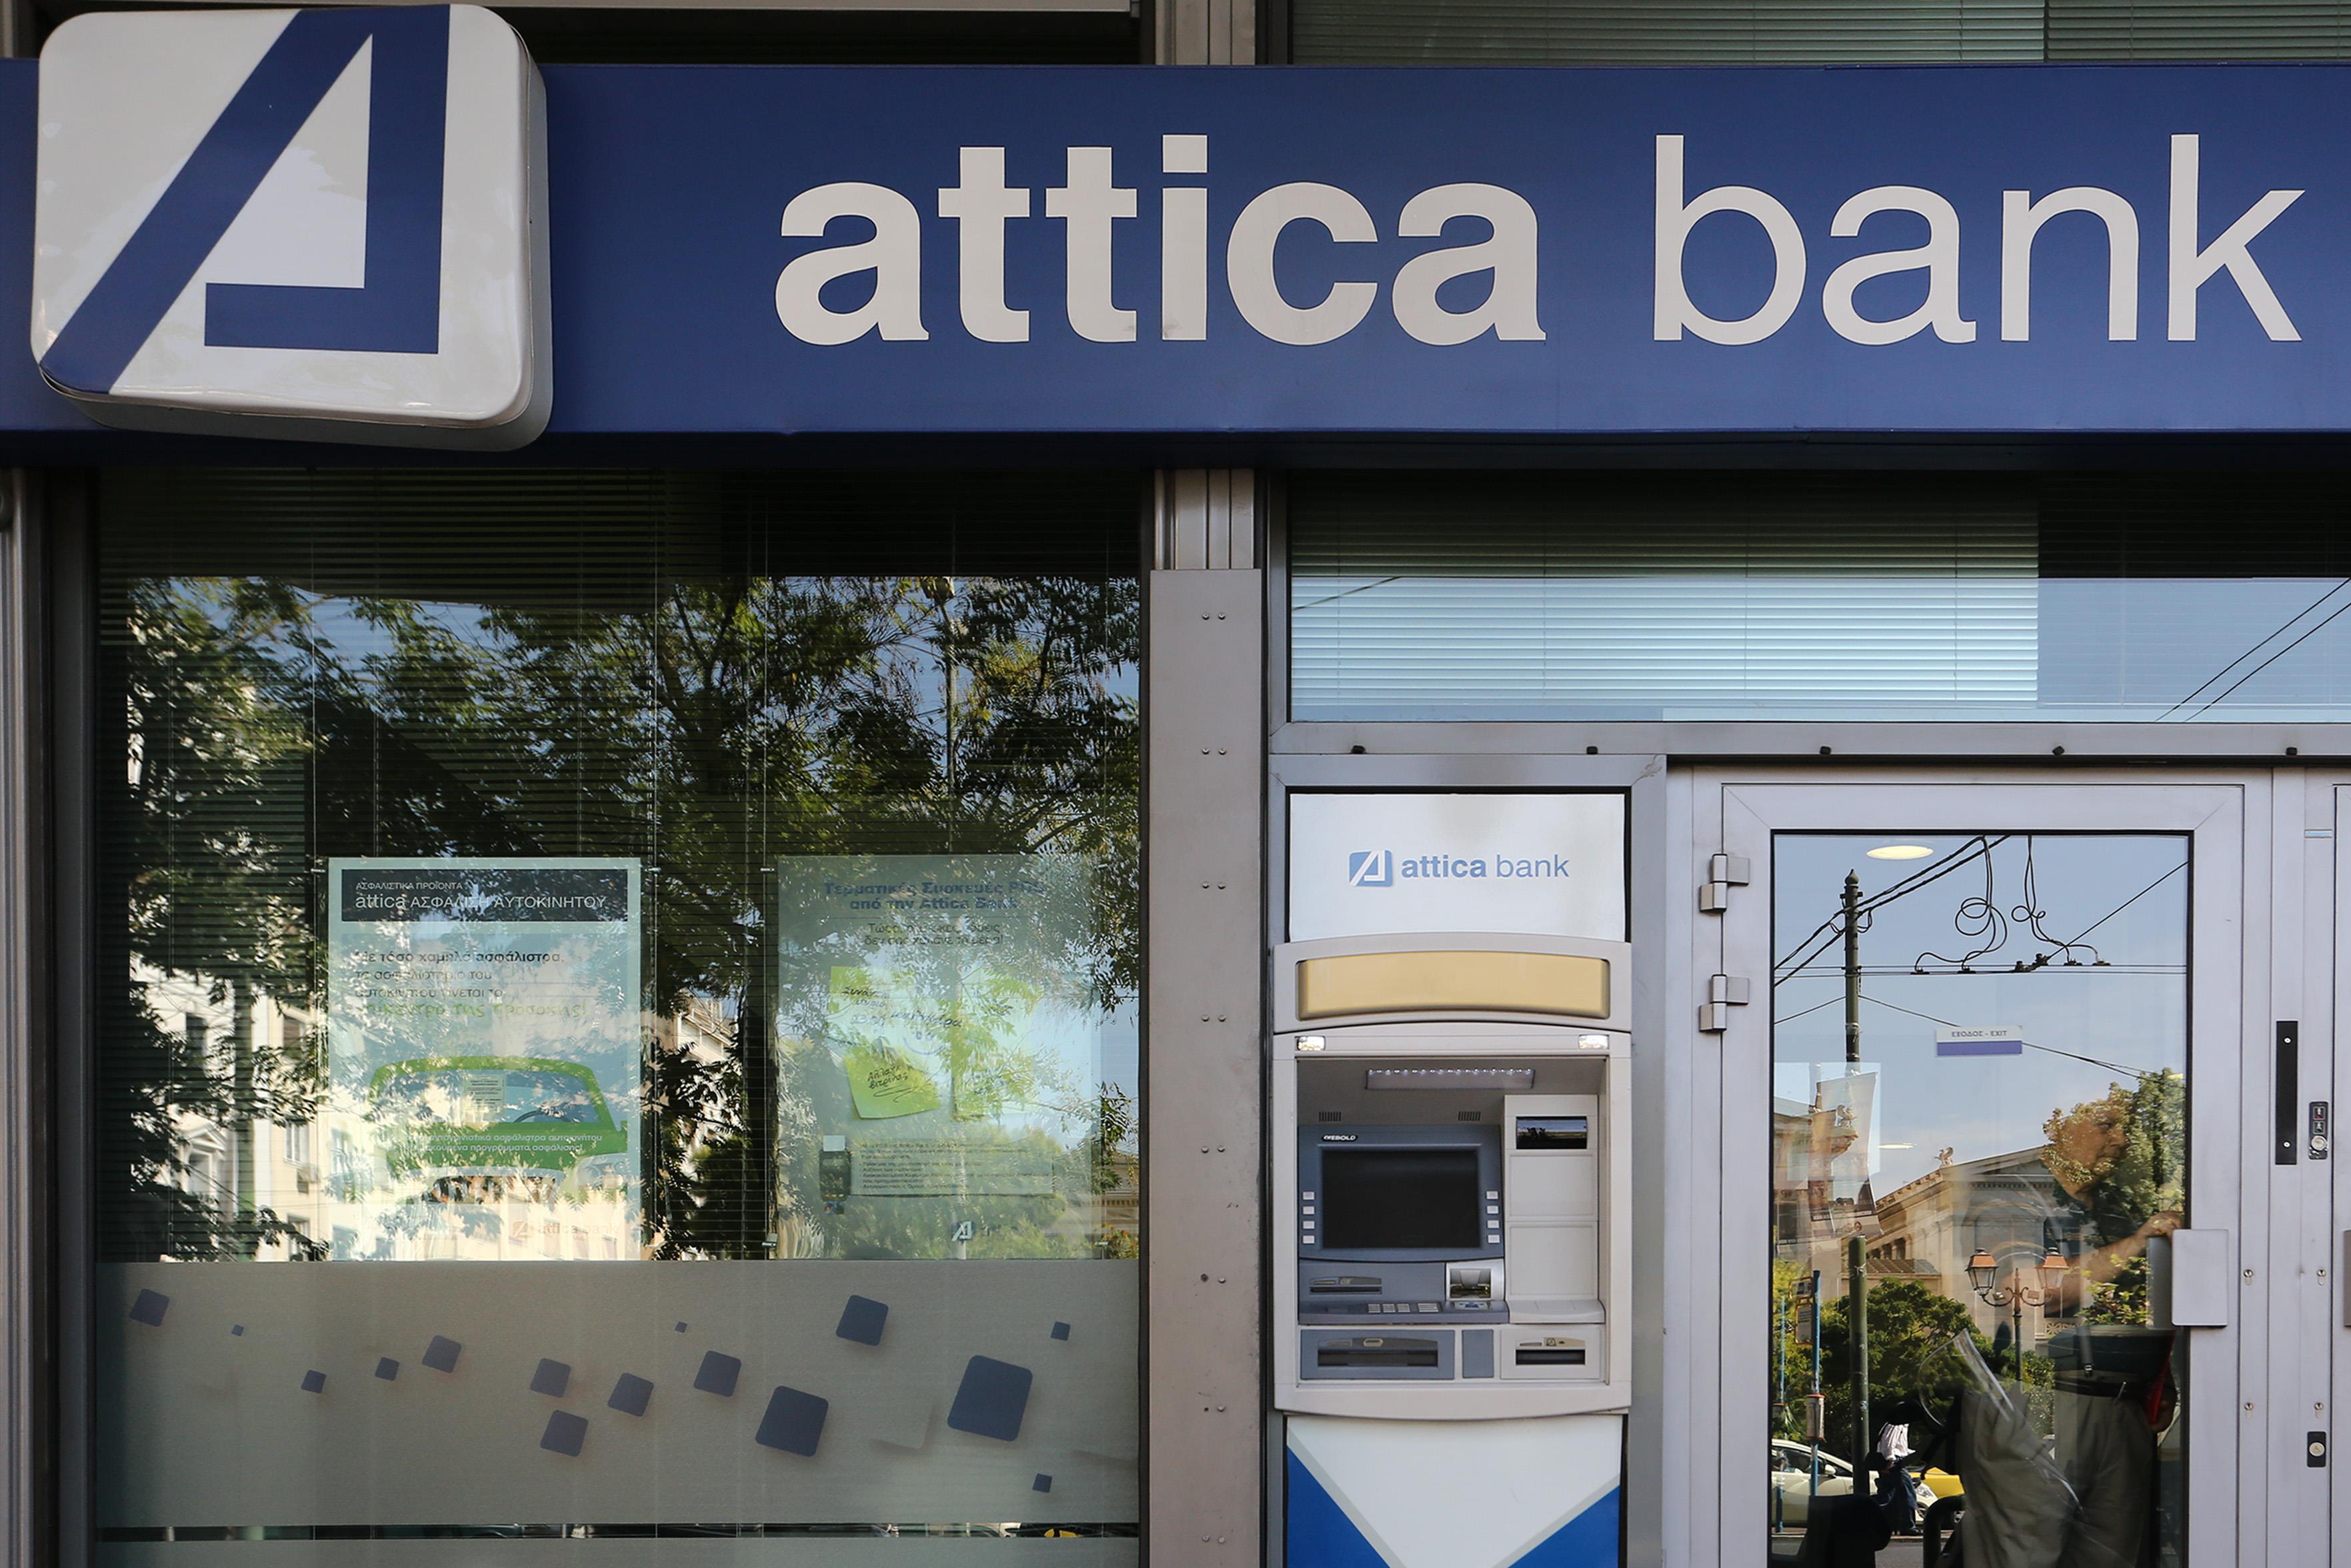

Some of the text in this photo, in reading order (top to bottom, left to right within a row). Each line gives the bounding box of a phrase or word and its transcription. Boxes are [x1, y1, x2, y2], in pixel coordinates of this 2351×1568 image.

[775, 133, 2306, 346] attica bank
[1401, 854, 1570, 878] attica bank
[355, 882, 415, 890] ΑΣΦΑΛΙΣΤΙΚΑ
[355, 894, 607, 908] attica ΑΣΦΑΛΙΣΗ ΑΥΤΟΚΙΝΗΤΟΥ
[850, 898, 881, 910] από
[476, 950, 564, 964] ασφάλιστρα,
[493, 1134, 546, 1142] ασφάλιστρα
